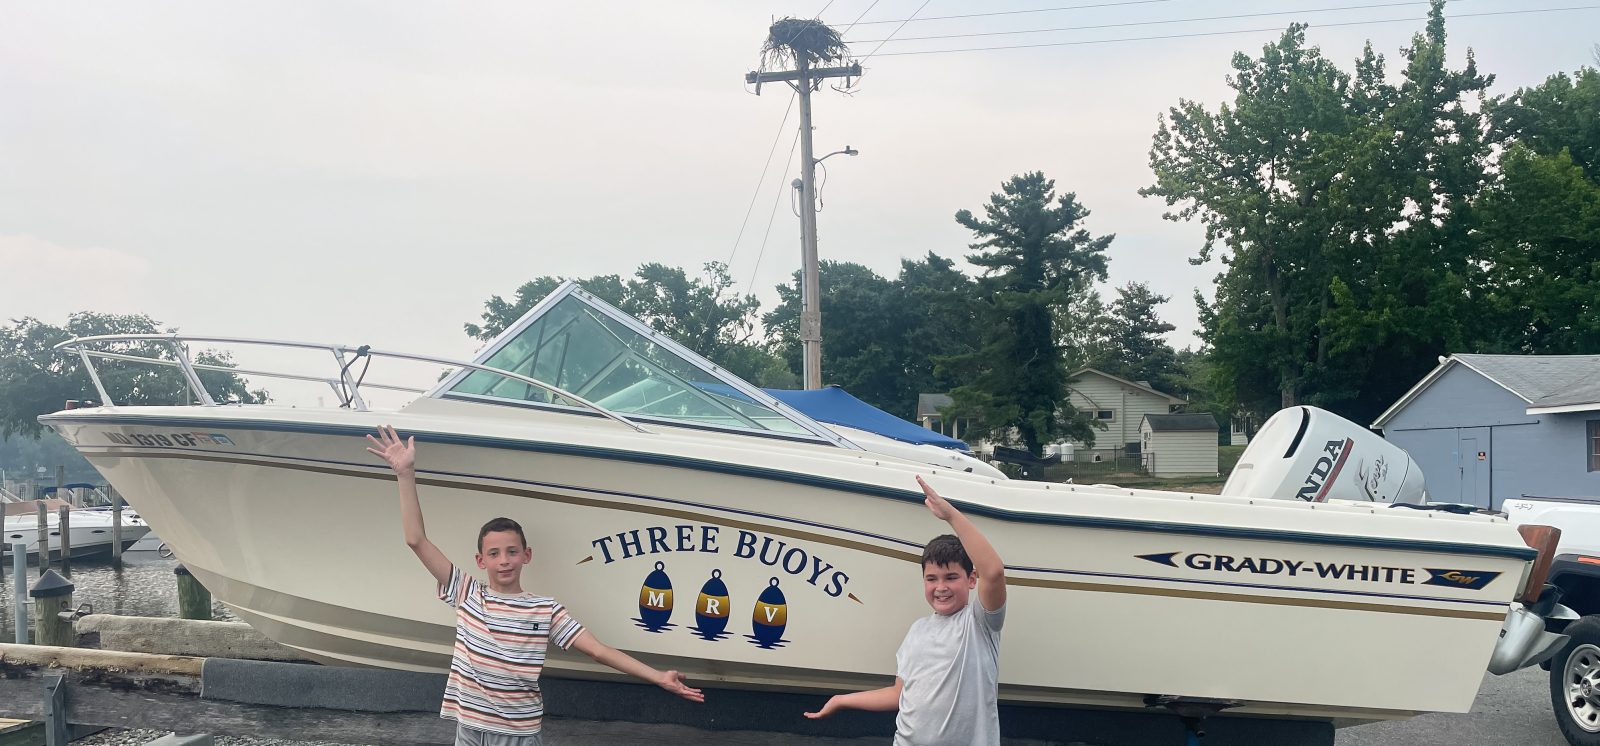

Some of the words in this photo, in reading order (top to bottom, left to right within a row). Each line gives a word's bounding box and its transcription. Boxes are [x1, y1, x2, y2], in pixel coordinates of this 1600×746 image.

[129, 433, 174, 447] 1319
[170, 433, 197, 447] CF
[1295, 439, 1345, 502] NDA
[592, 525, 720, 564] THREE
[733, 530, 850, 598] BUOYS
[1184, 552, 1415, 585] GRADY-WHITE
[648, 591, 665, 608] M
[705, 598, 720, 615] R
[764, 607, 778, 623] V
